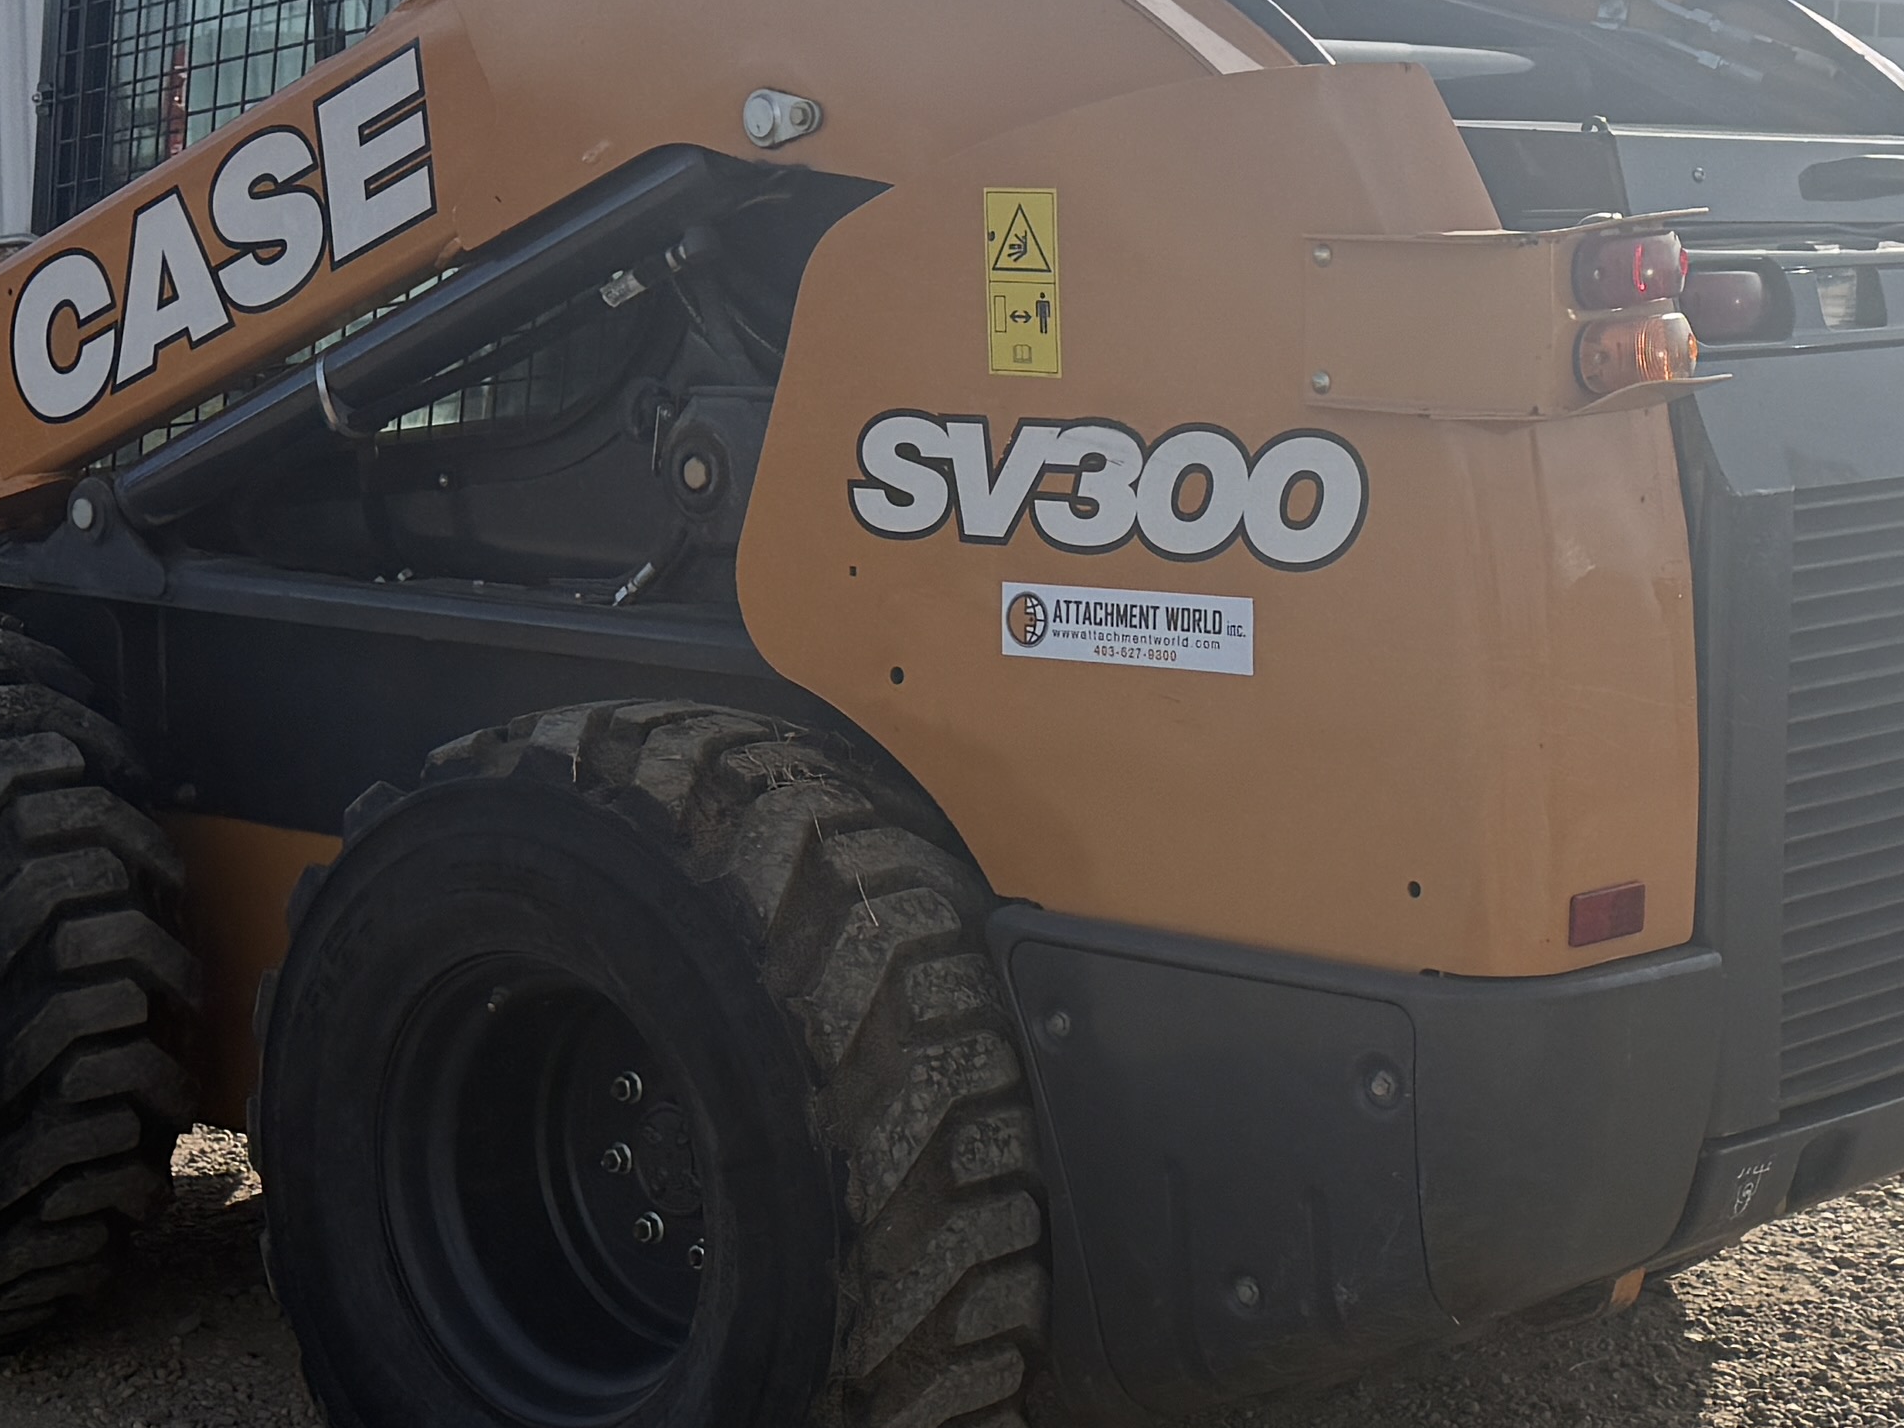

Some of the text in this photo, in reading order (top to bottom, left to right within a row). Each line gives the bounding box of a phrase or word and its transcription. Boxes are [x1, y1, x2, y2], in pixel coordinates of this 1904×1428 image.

[10, 37, 437, 424] CASE
[847, 408, 1369, 571] SV300
[1053, 599, 1247, 638] ATTACHMENT WORLD inc.
